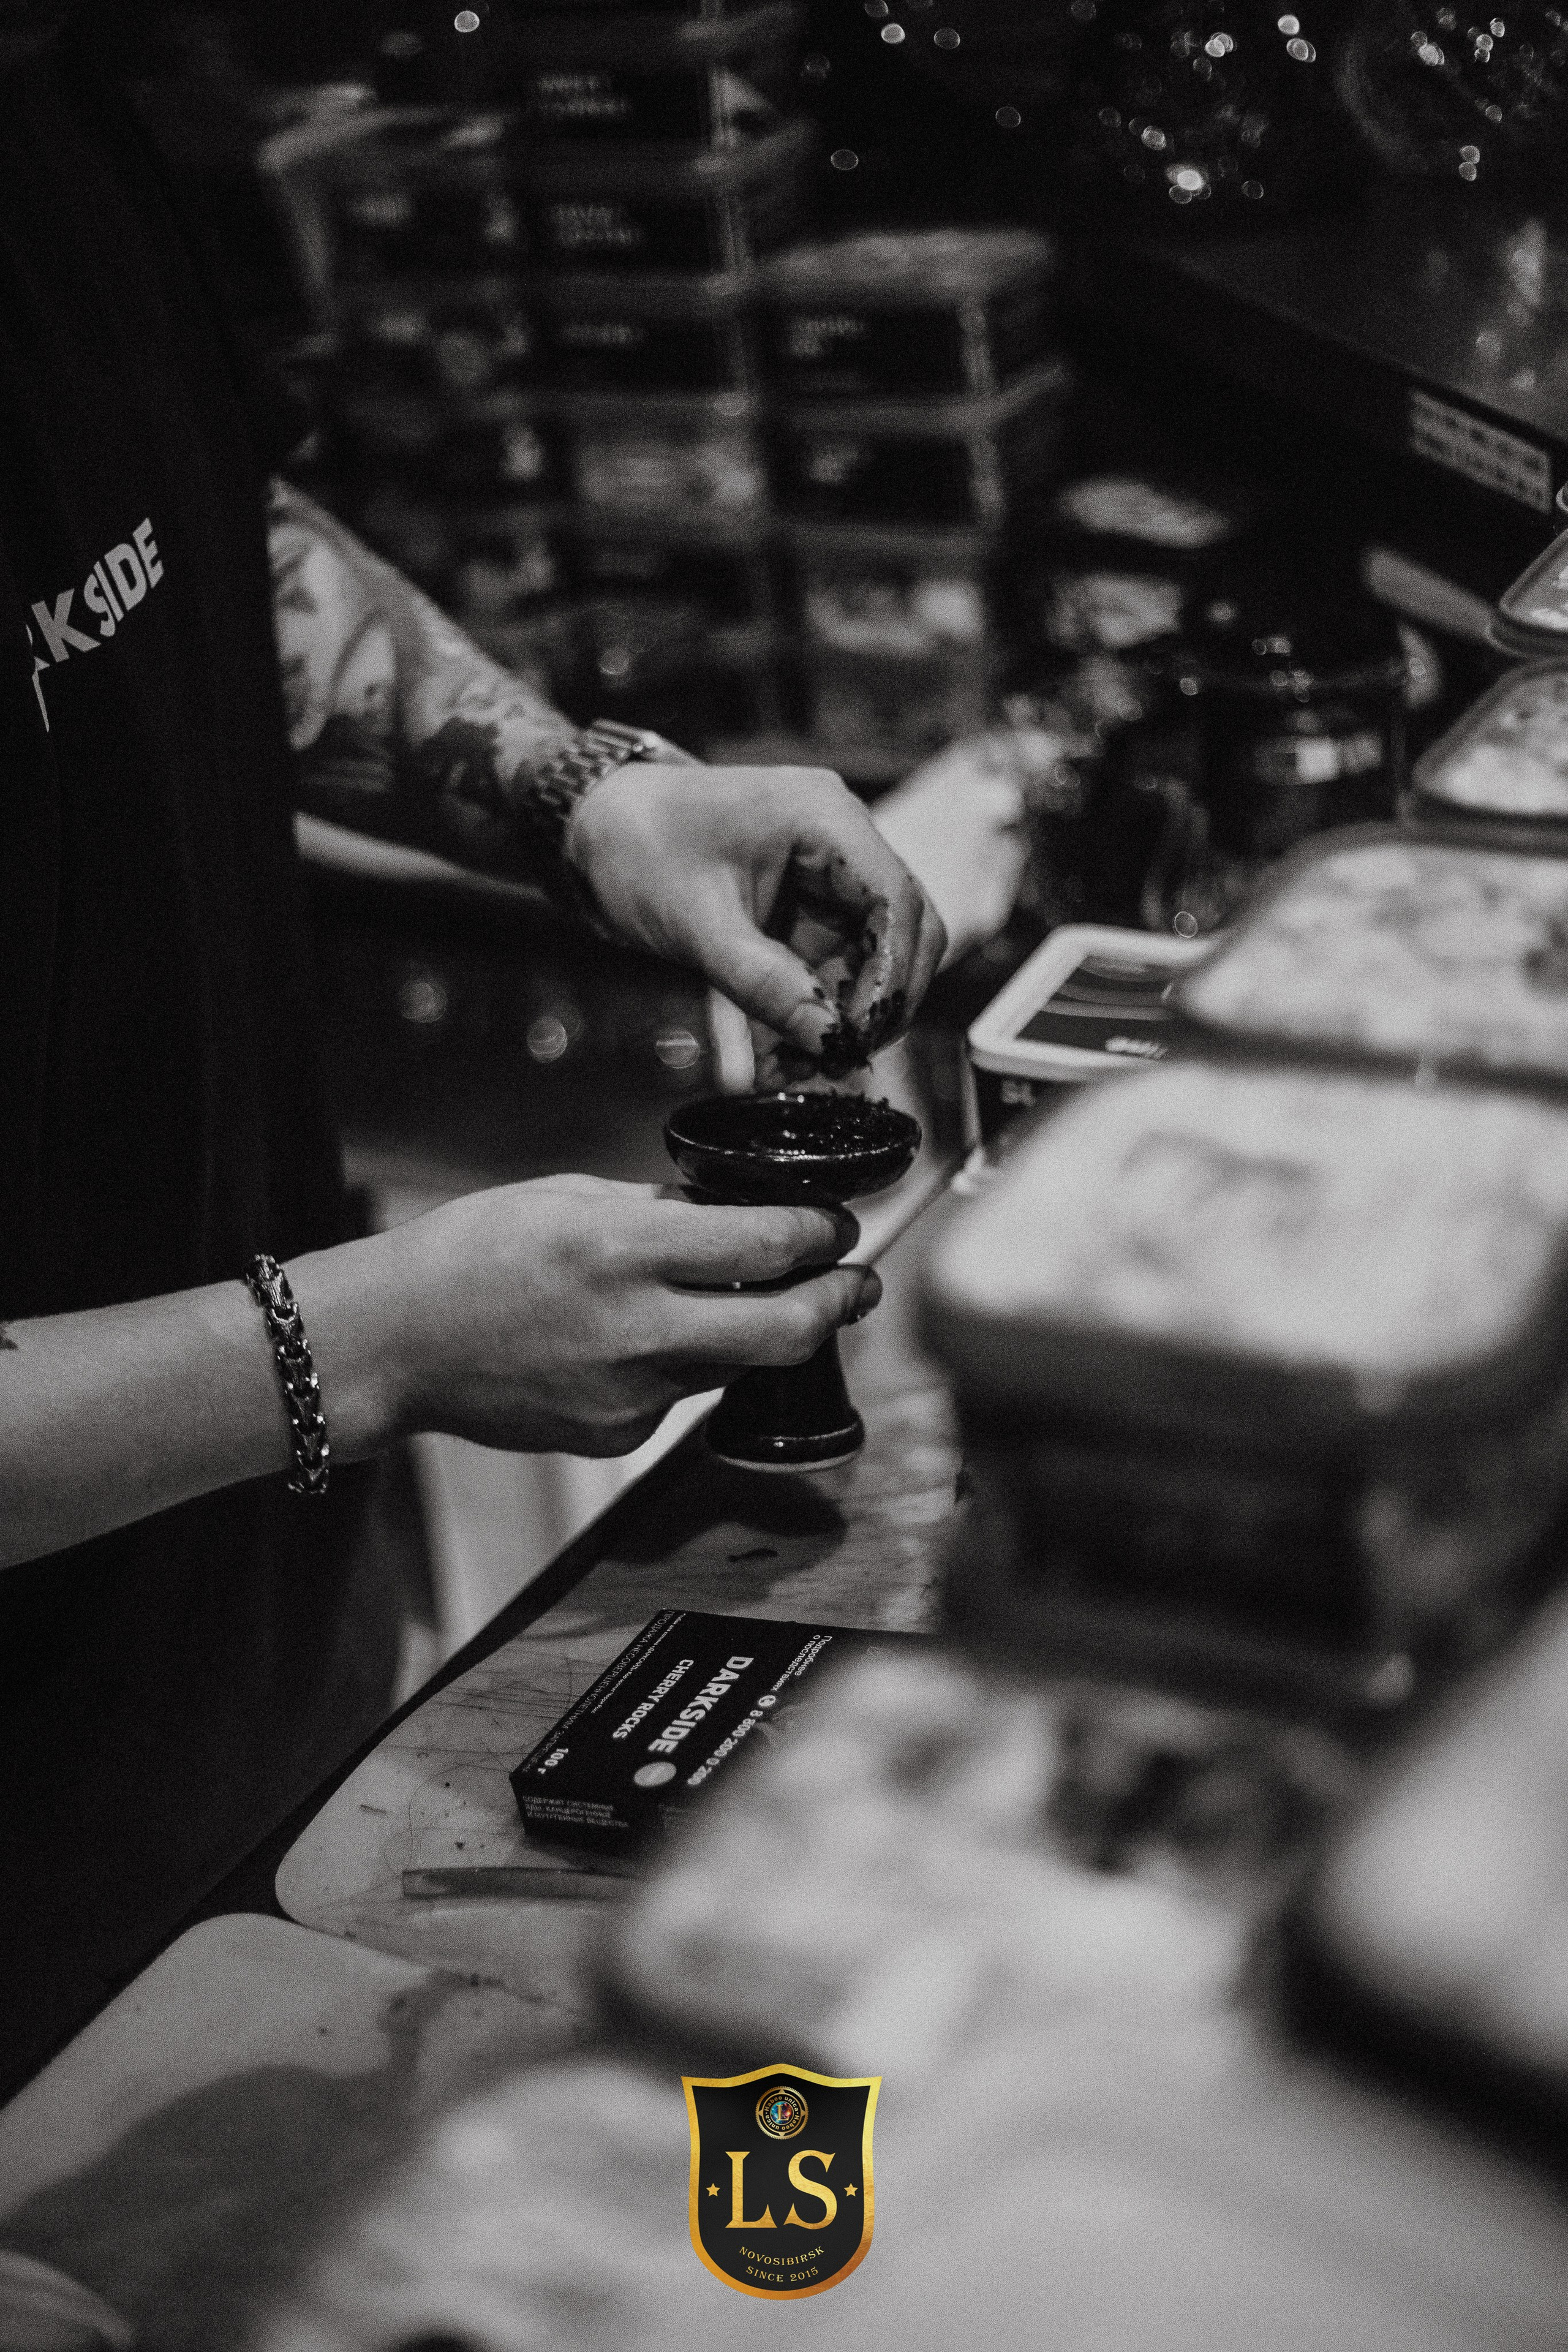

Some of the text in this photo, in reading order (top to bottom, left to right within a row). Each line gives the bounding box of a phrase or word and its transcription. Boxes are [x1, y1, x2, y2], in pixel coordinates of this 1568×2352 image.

[643, 1610, 674, 1643] ПРОДАЖА
[771, 1641, 816, 1691] последствиях
[794, 1635, 832, 1676] Подробнее
[564, 1644, 643, 1729] НЕСОВЕРШЕННОЛЕТНИМ
[647, 1659, 694, 1702] CHERRY
[612, 1702, 655, 1739] ROCKS
[647, 1656, 754, 1753] DARKSIDE
[732, 1718, 756, 1737] 800
[545, 1748, 568, 1766] 100
[714, 1738, 739, 1757] 200
